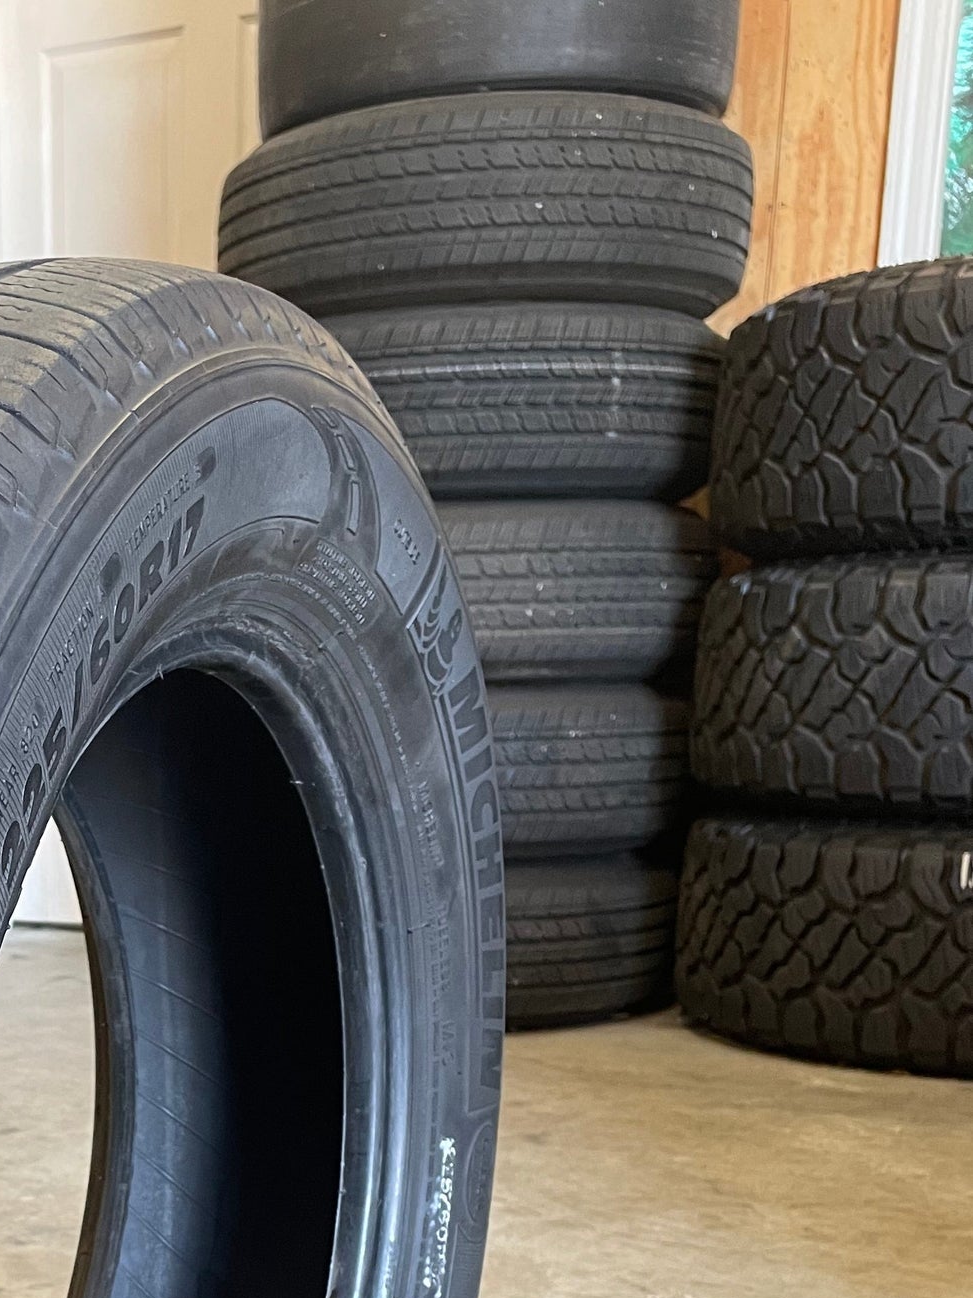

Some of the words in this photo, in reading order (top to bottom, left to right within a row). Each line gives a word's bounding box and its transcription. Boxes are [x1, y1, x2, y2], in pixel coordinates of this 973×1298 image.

[1, 495, 205, 888] 225/60R17
[46, 602, 94, 690] TRACTION
[126, 472, 191, 554] TEMPERATURE
